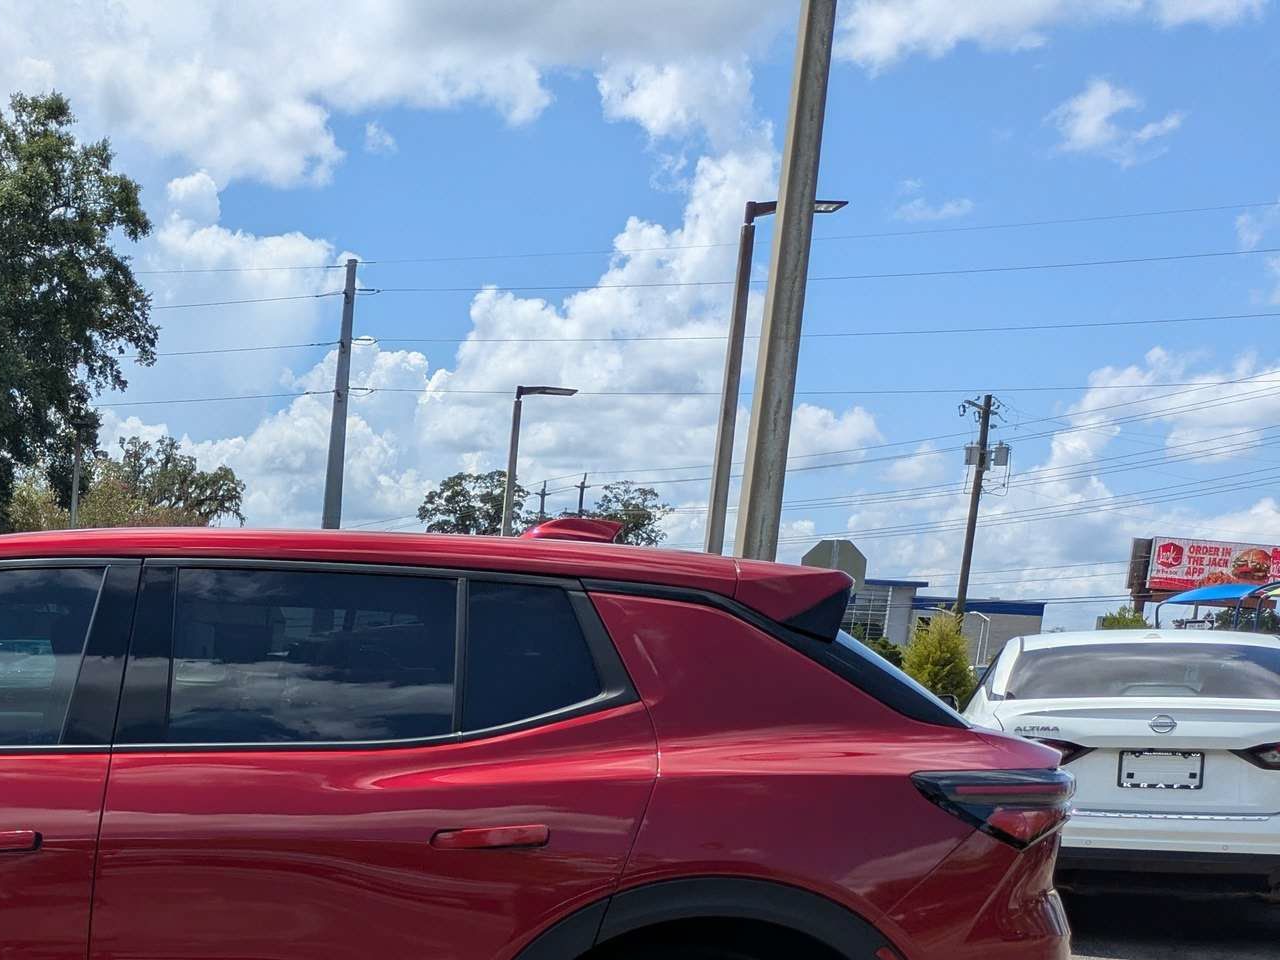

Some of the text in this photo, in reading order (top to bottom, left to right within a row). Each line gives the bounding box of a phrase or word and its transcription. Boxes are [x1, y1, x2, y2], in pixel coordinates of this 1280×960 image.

[1188, 545, 1233, 557] ORDER IN
[1187, 556, 1229, 568] THE JACK
[1185, 567, 1205, 577] APP
[1123, 782, 1197, 790] KRAFT
